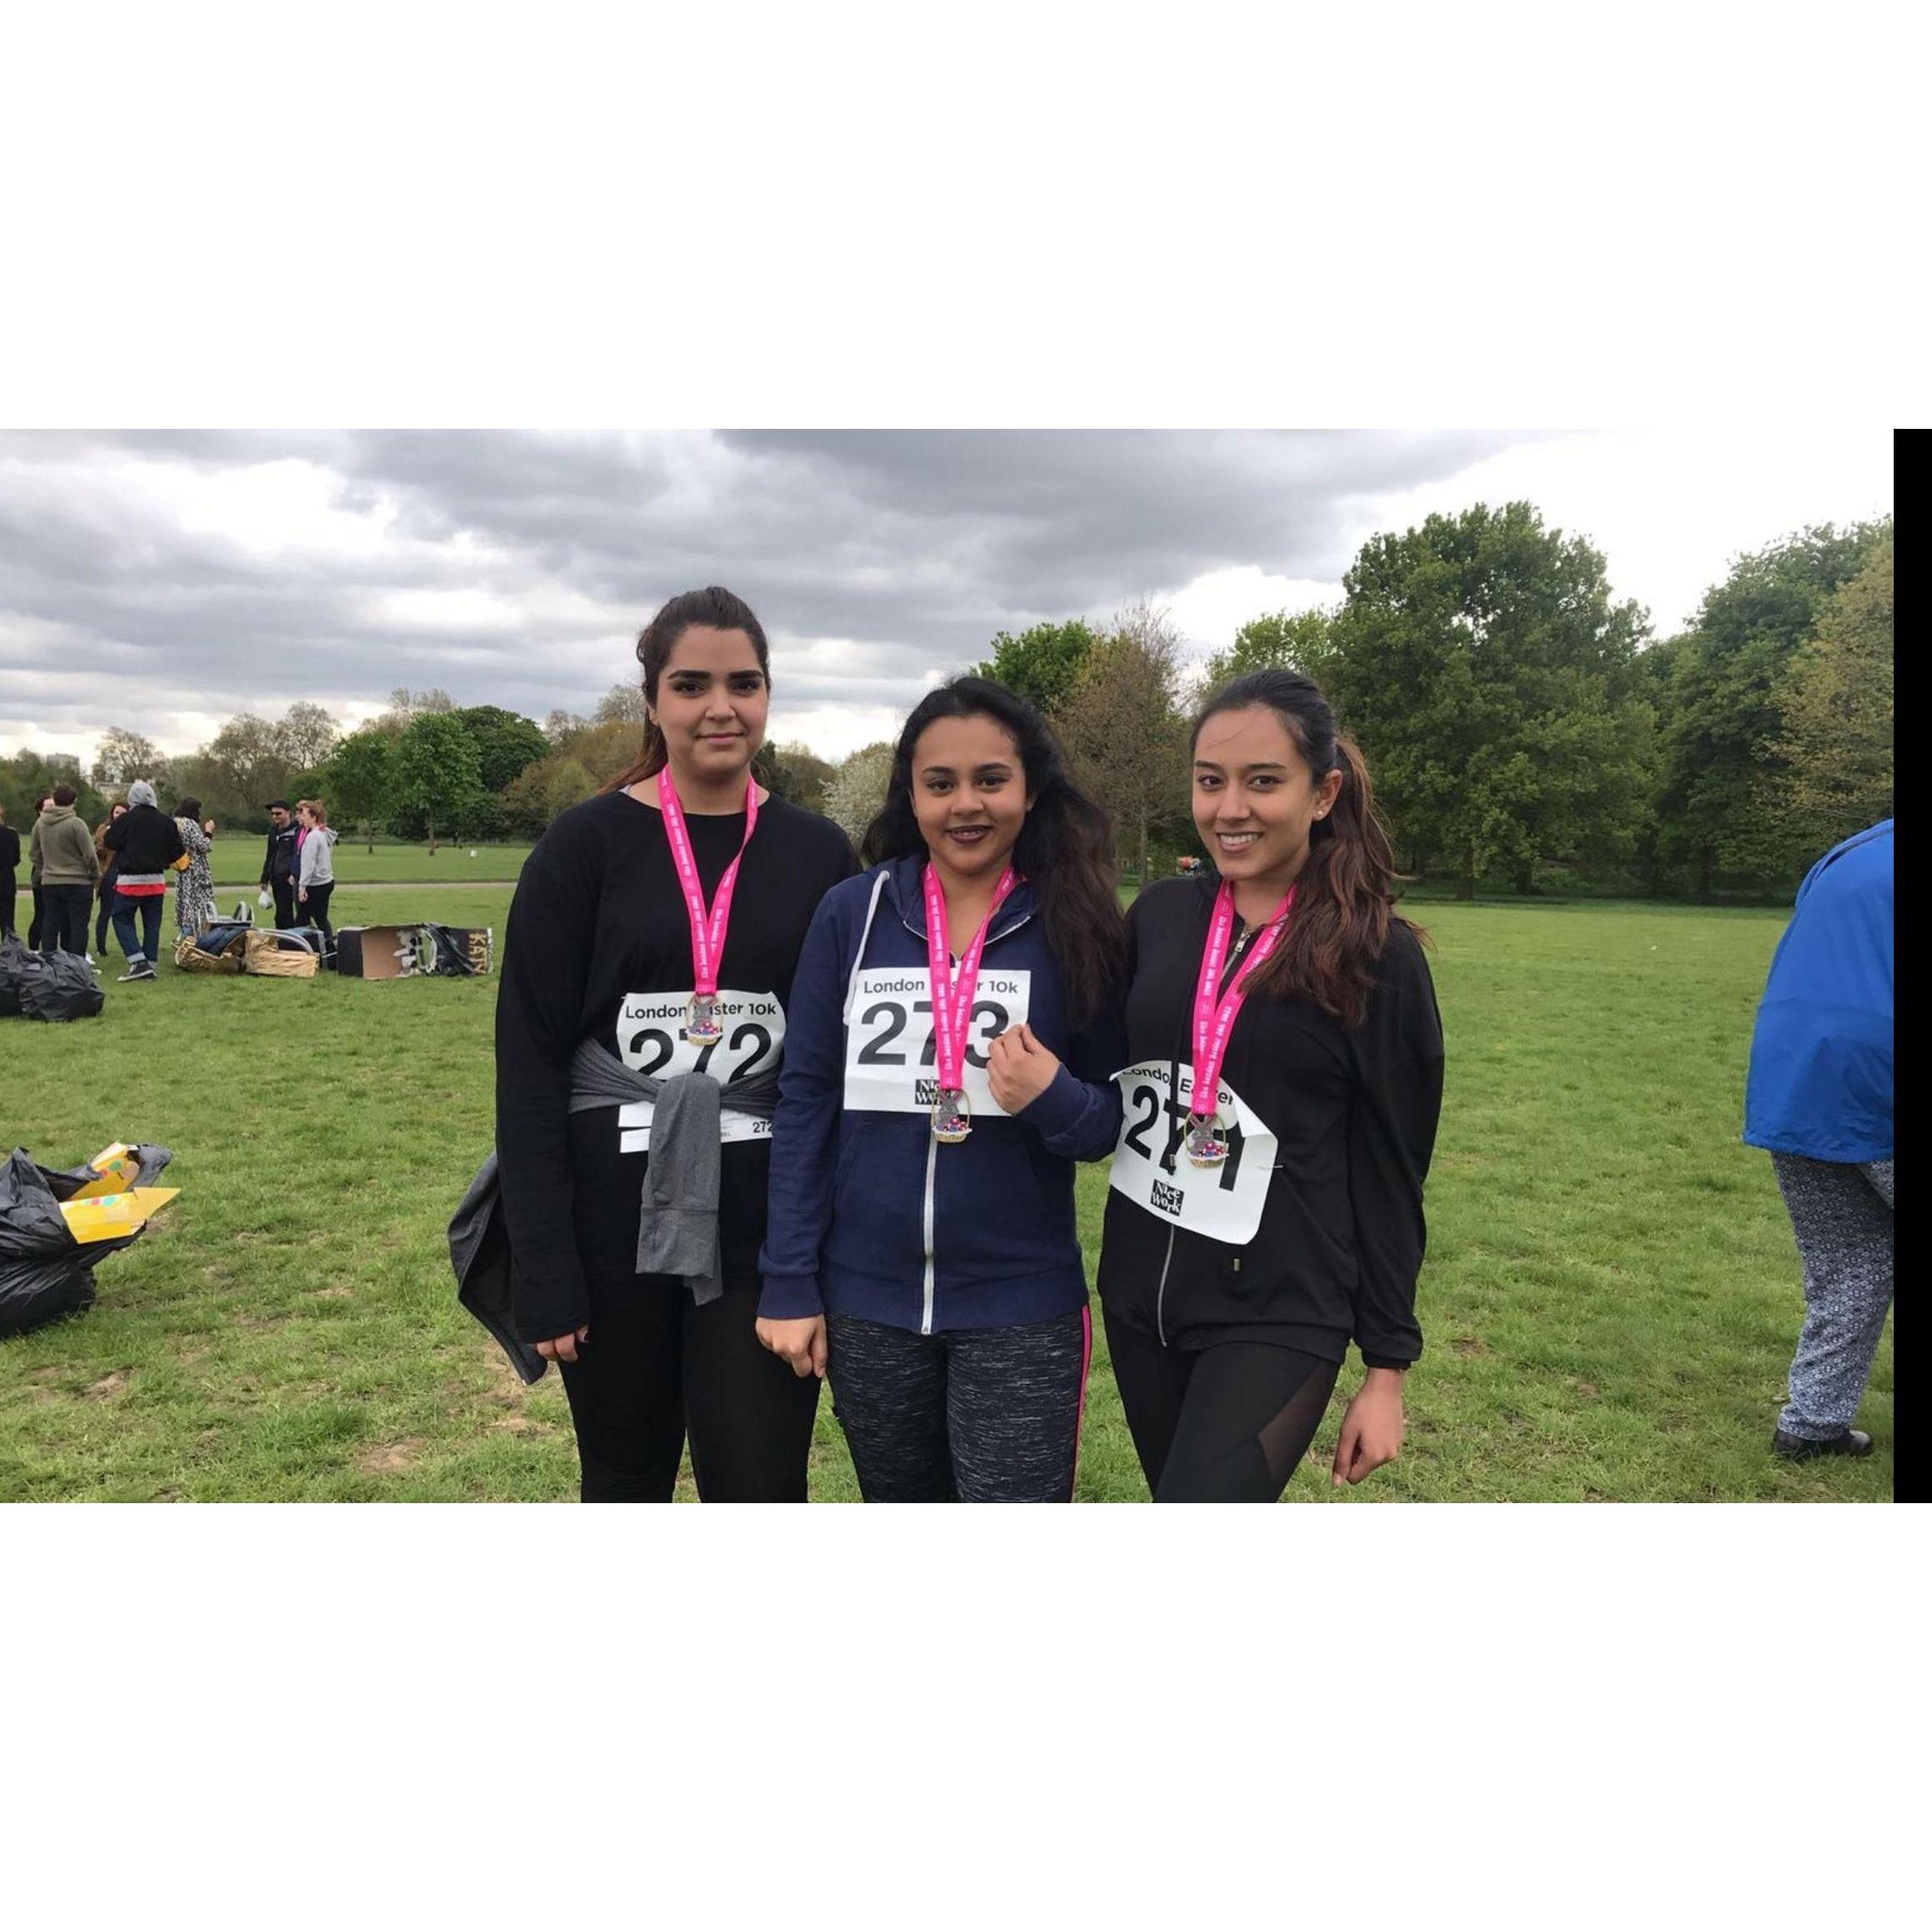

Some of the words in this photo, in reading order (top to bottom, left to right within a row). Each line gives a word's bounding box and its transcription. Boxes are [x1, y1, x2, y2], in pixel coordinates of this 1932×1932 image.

[864, 978, 925, 993] London
[989, 980, 1018, 993] 10k
[625, 1004, 687, 1018] London
[749, 1003, 776, 1015] 10k
[858, 1000, 1008, 1069] 273
[630, 1023, 772, 1083] 272
[1123, 1068, 1170, 1083] ondo
[752, 1119, 773, 1133] 272
[1155, 1183, 1182, 1199] Nice
